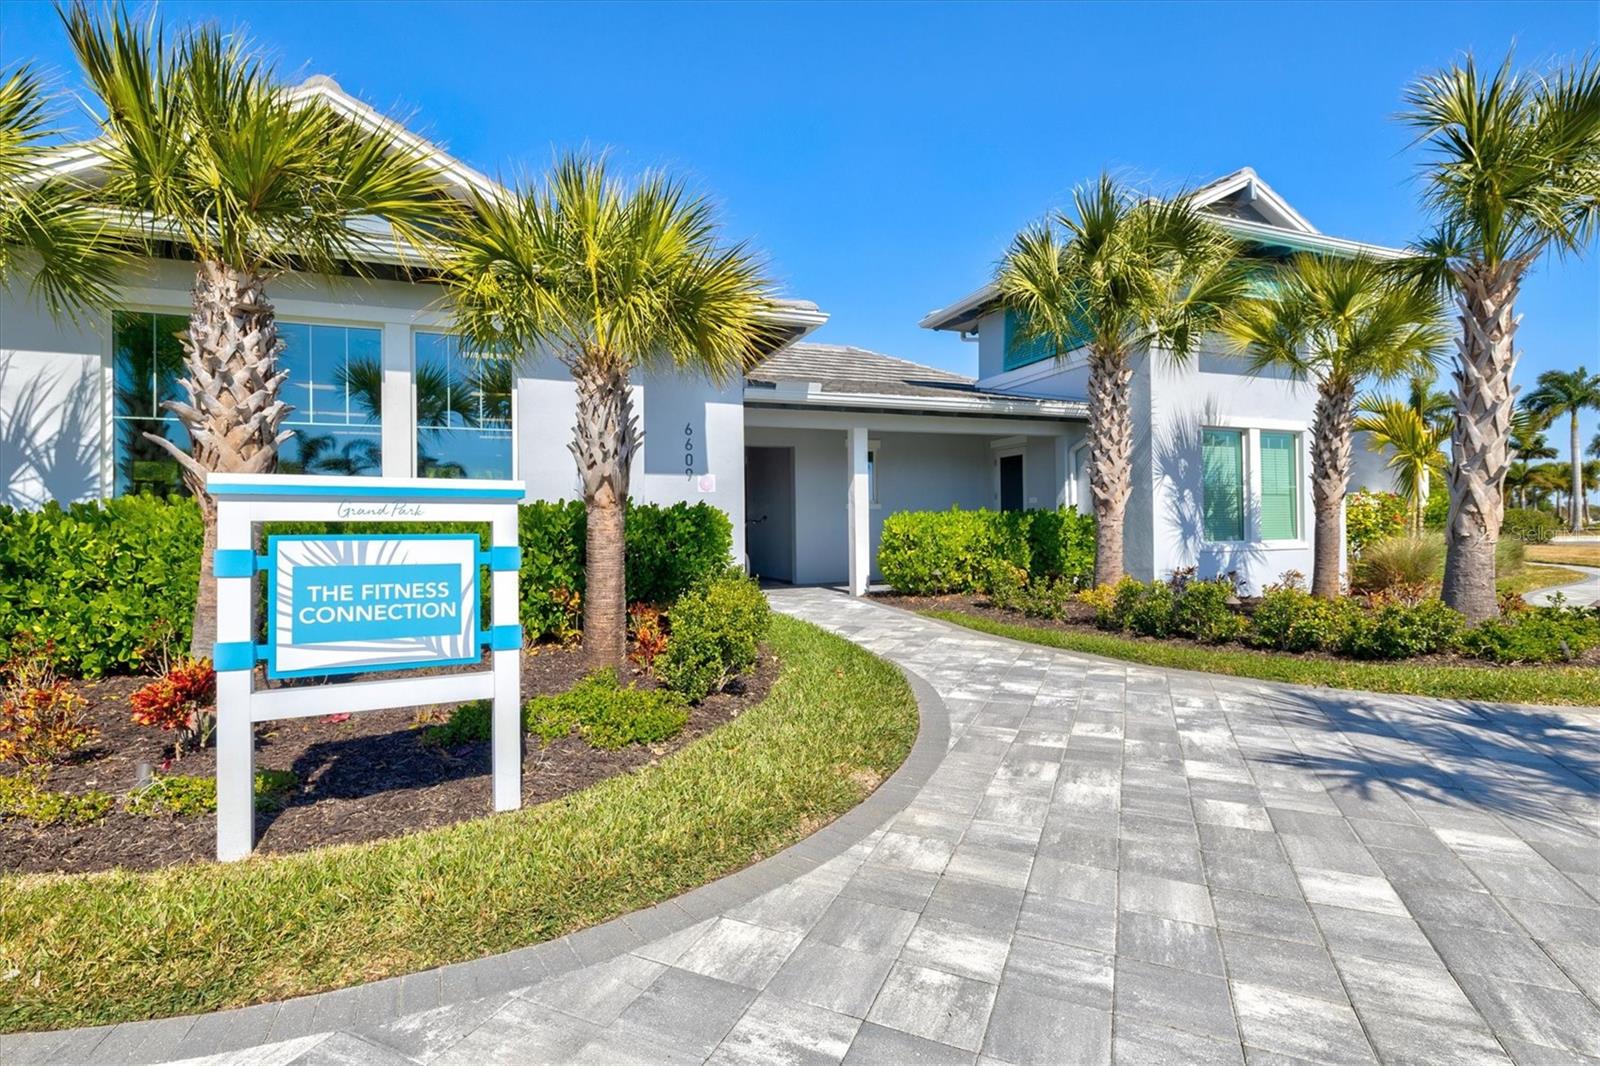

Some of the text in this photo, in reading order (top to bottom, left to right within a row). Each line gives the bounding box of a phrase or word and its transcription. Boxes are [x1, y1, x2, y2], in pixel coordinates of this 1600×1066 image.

[685, 422, 694, 482] 6609
[337, 498, 424, 518] Grand Park
[307, 582, 449, 602] THE FITNESS
[299, 602, 456, 624] CONNECTION
